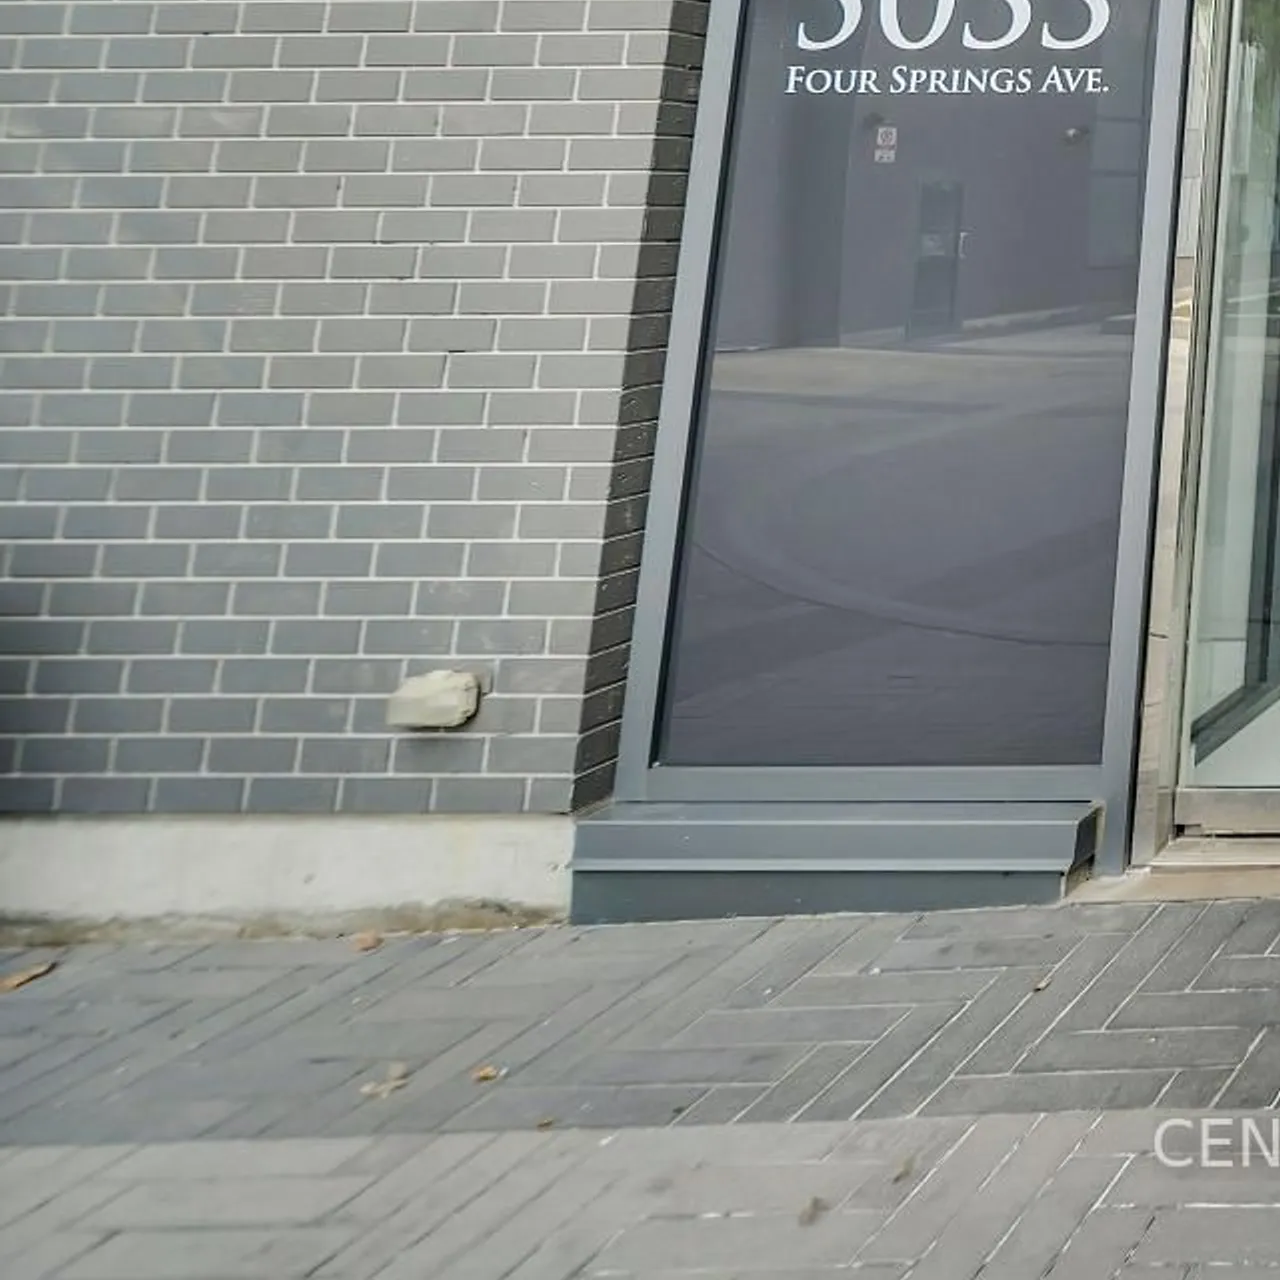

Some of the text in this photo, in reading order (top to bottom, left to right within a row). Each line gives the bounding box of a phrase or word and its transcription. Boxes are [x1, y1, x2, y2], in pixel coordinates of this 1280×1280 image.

[785, 65, 1110, 95] FOUR SPRINGS AVE.
